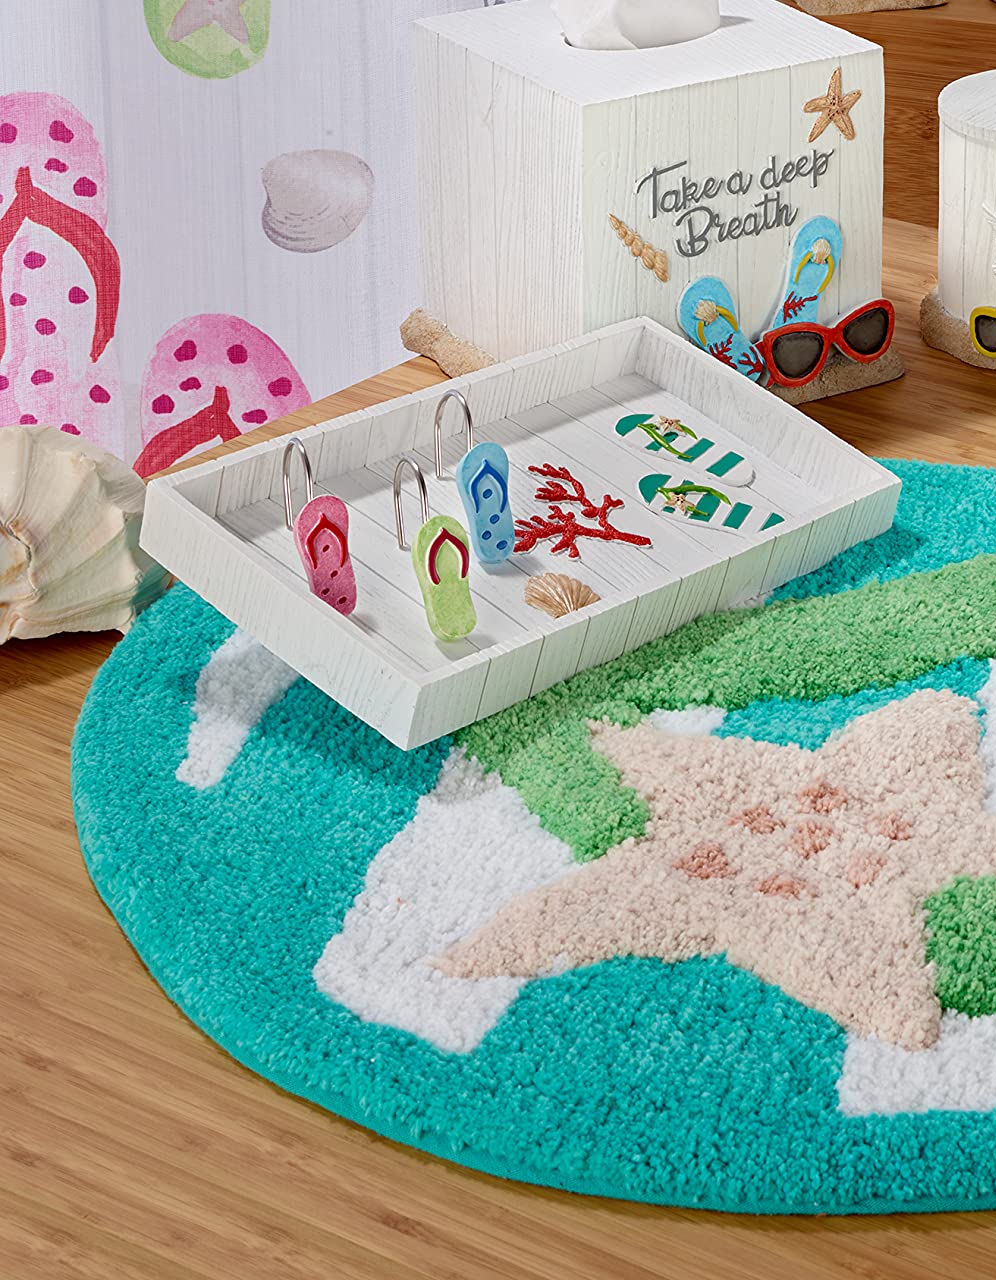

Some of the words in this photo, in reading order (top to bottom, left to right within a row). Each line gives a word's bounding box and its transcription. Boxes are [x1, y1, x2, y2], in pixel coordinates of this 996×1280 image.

[634, 160, 724, 219] Take
[726, 170, 752, 195] a
[759, 148, 835, 189] deep
[674, 191, 799, 258] Breath
